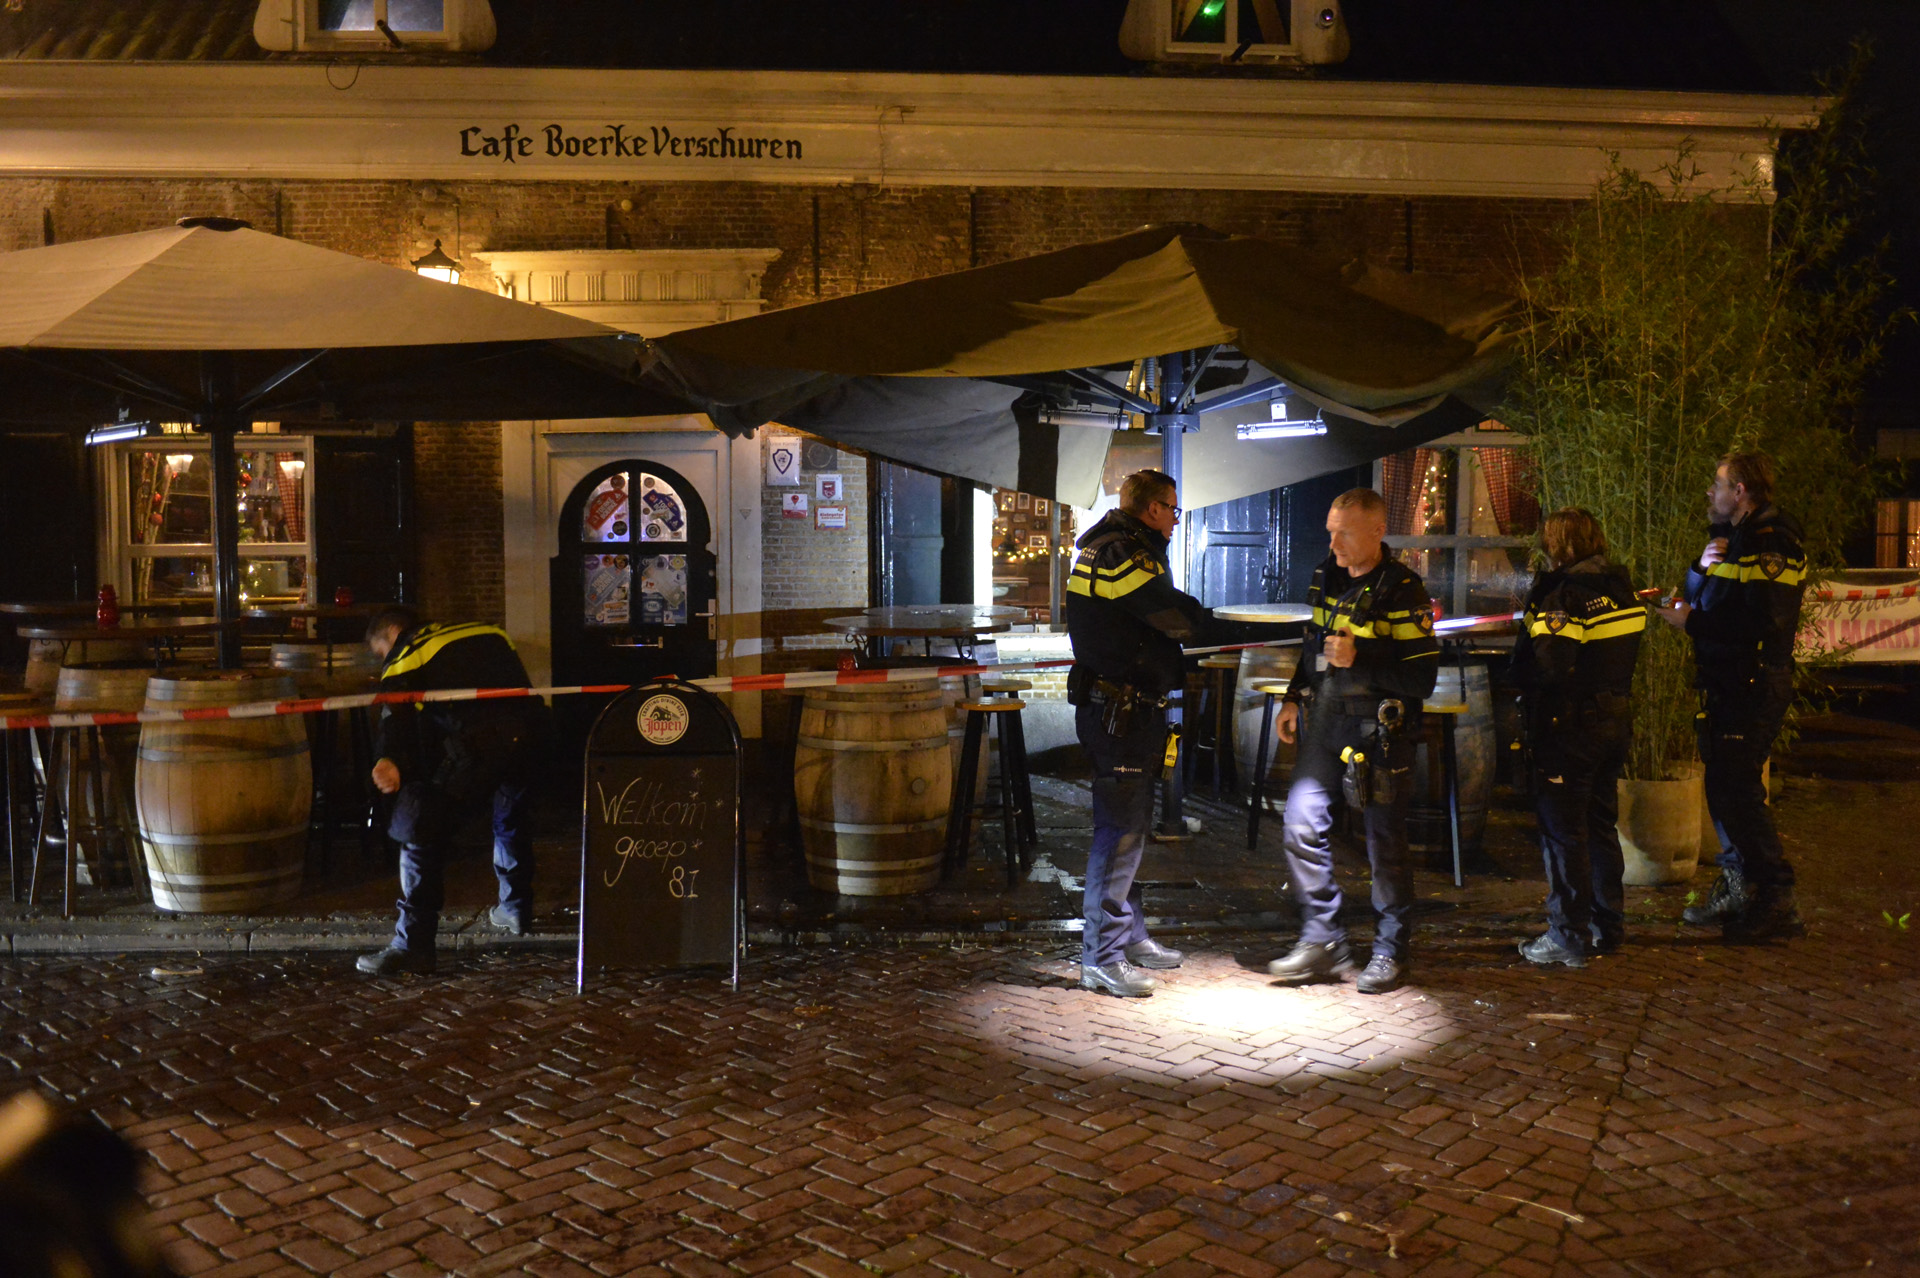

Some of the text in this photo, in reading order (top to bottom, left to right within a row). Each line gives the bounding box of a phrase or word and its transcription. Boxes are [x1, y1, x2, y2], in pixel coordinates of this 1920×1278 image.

[459, 123, 803, 164] Cafe Boerke Verschuren
[643, 717, 682, 736] Jopen
